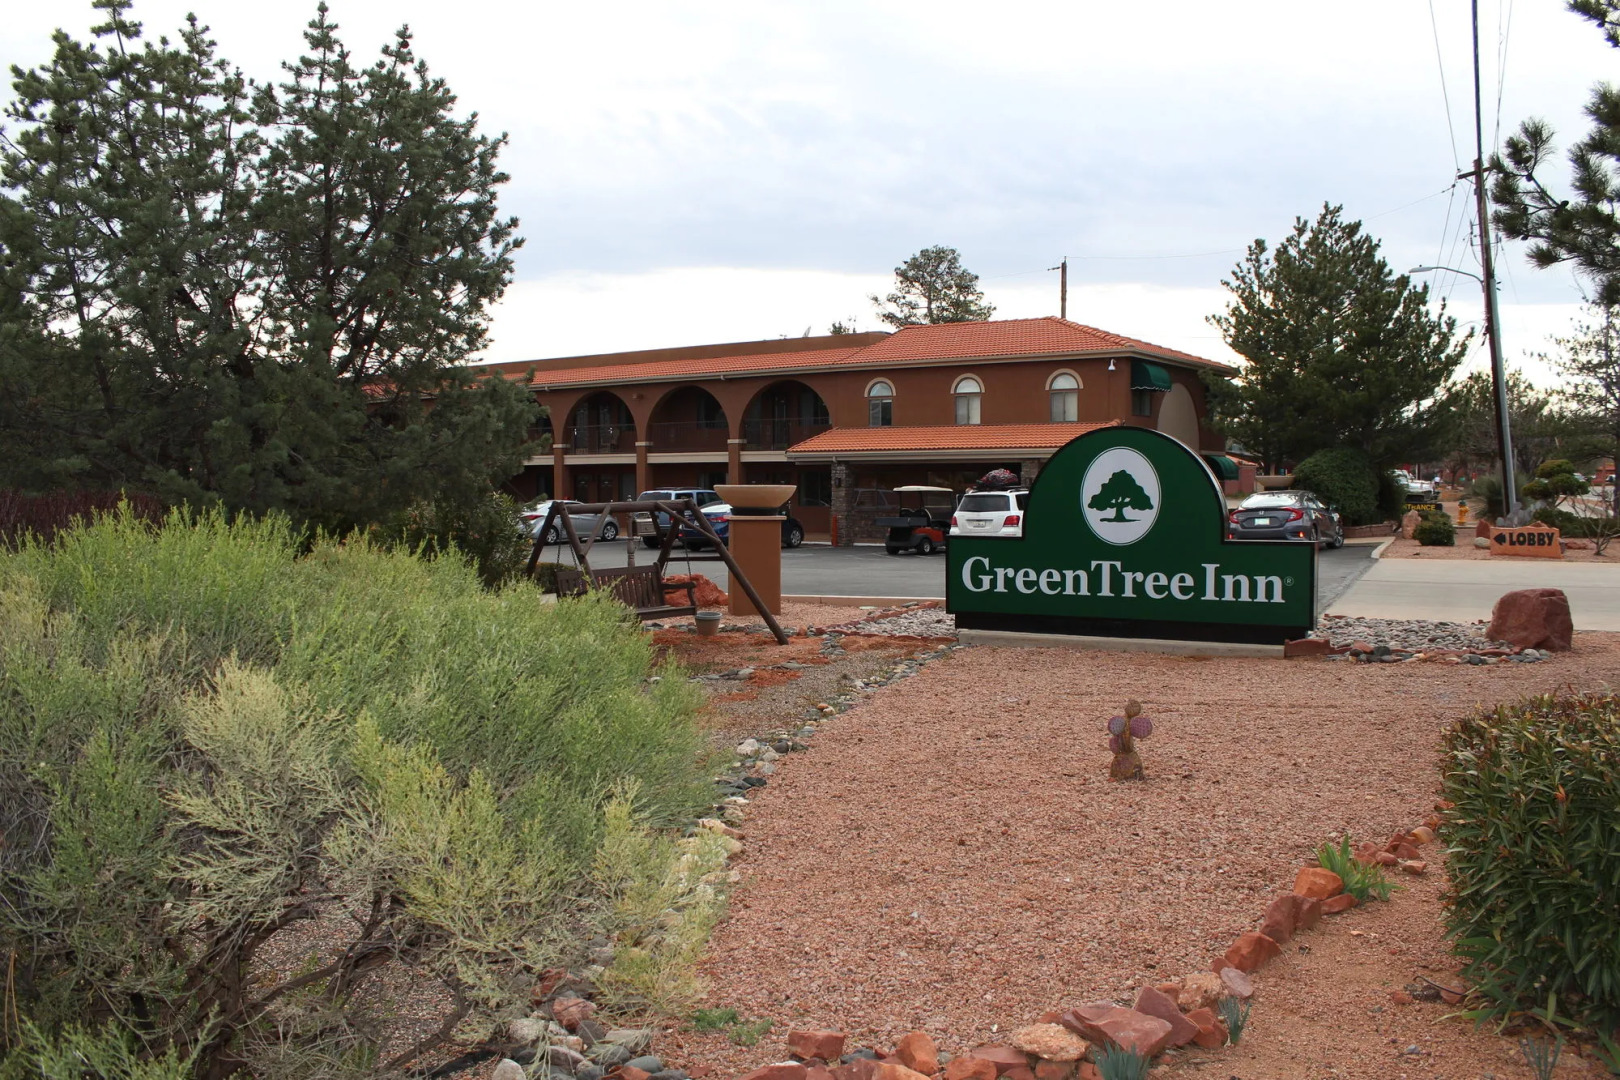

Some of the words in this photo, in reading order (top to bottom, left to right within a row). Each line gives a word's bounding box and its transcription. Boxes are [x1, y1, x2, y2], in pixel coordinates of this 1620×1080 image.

[1405, 503, 1436, 511] TRANCE
[1508, 532, 1555, 546] LOBBY
[961, 556, 1195, 600] GreenTree
